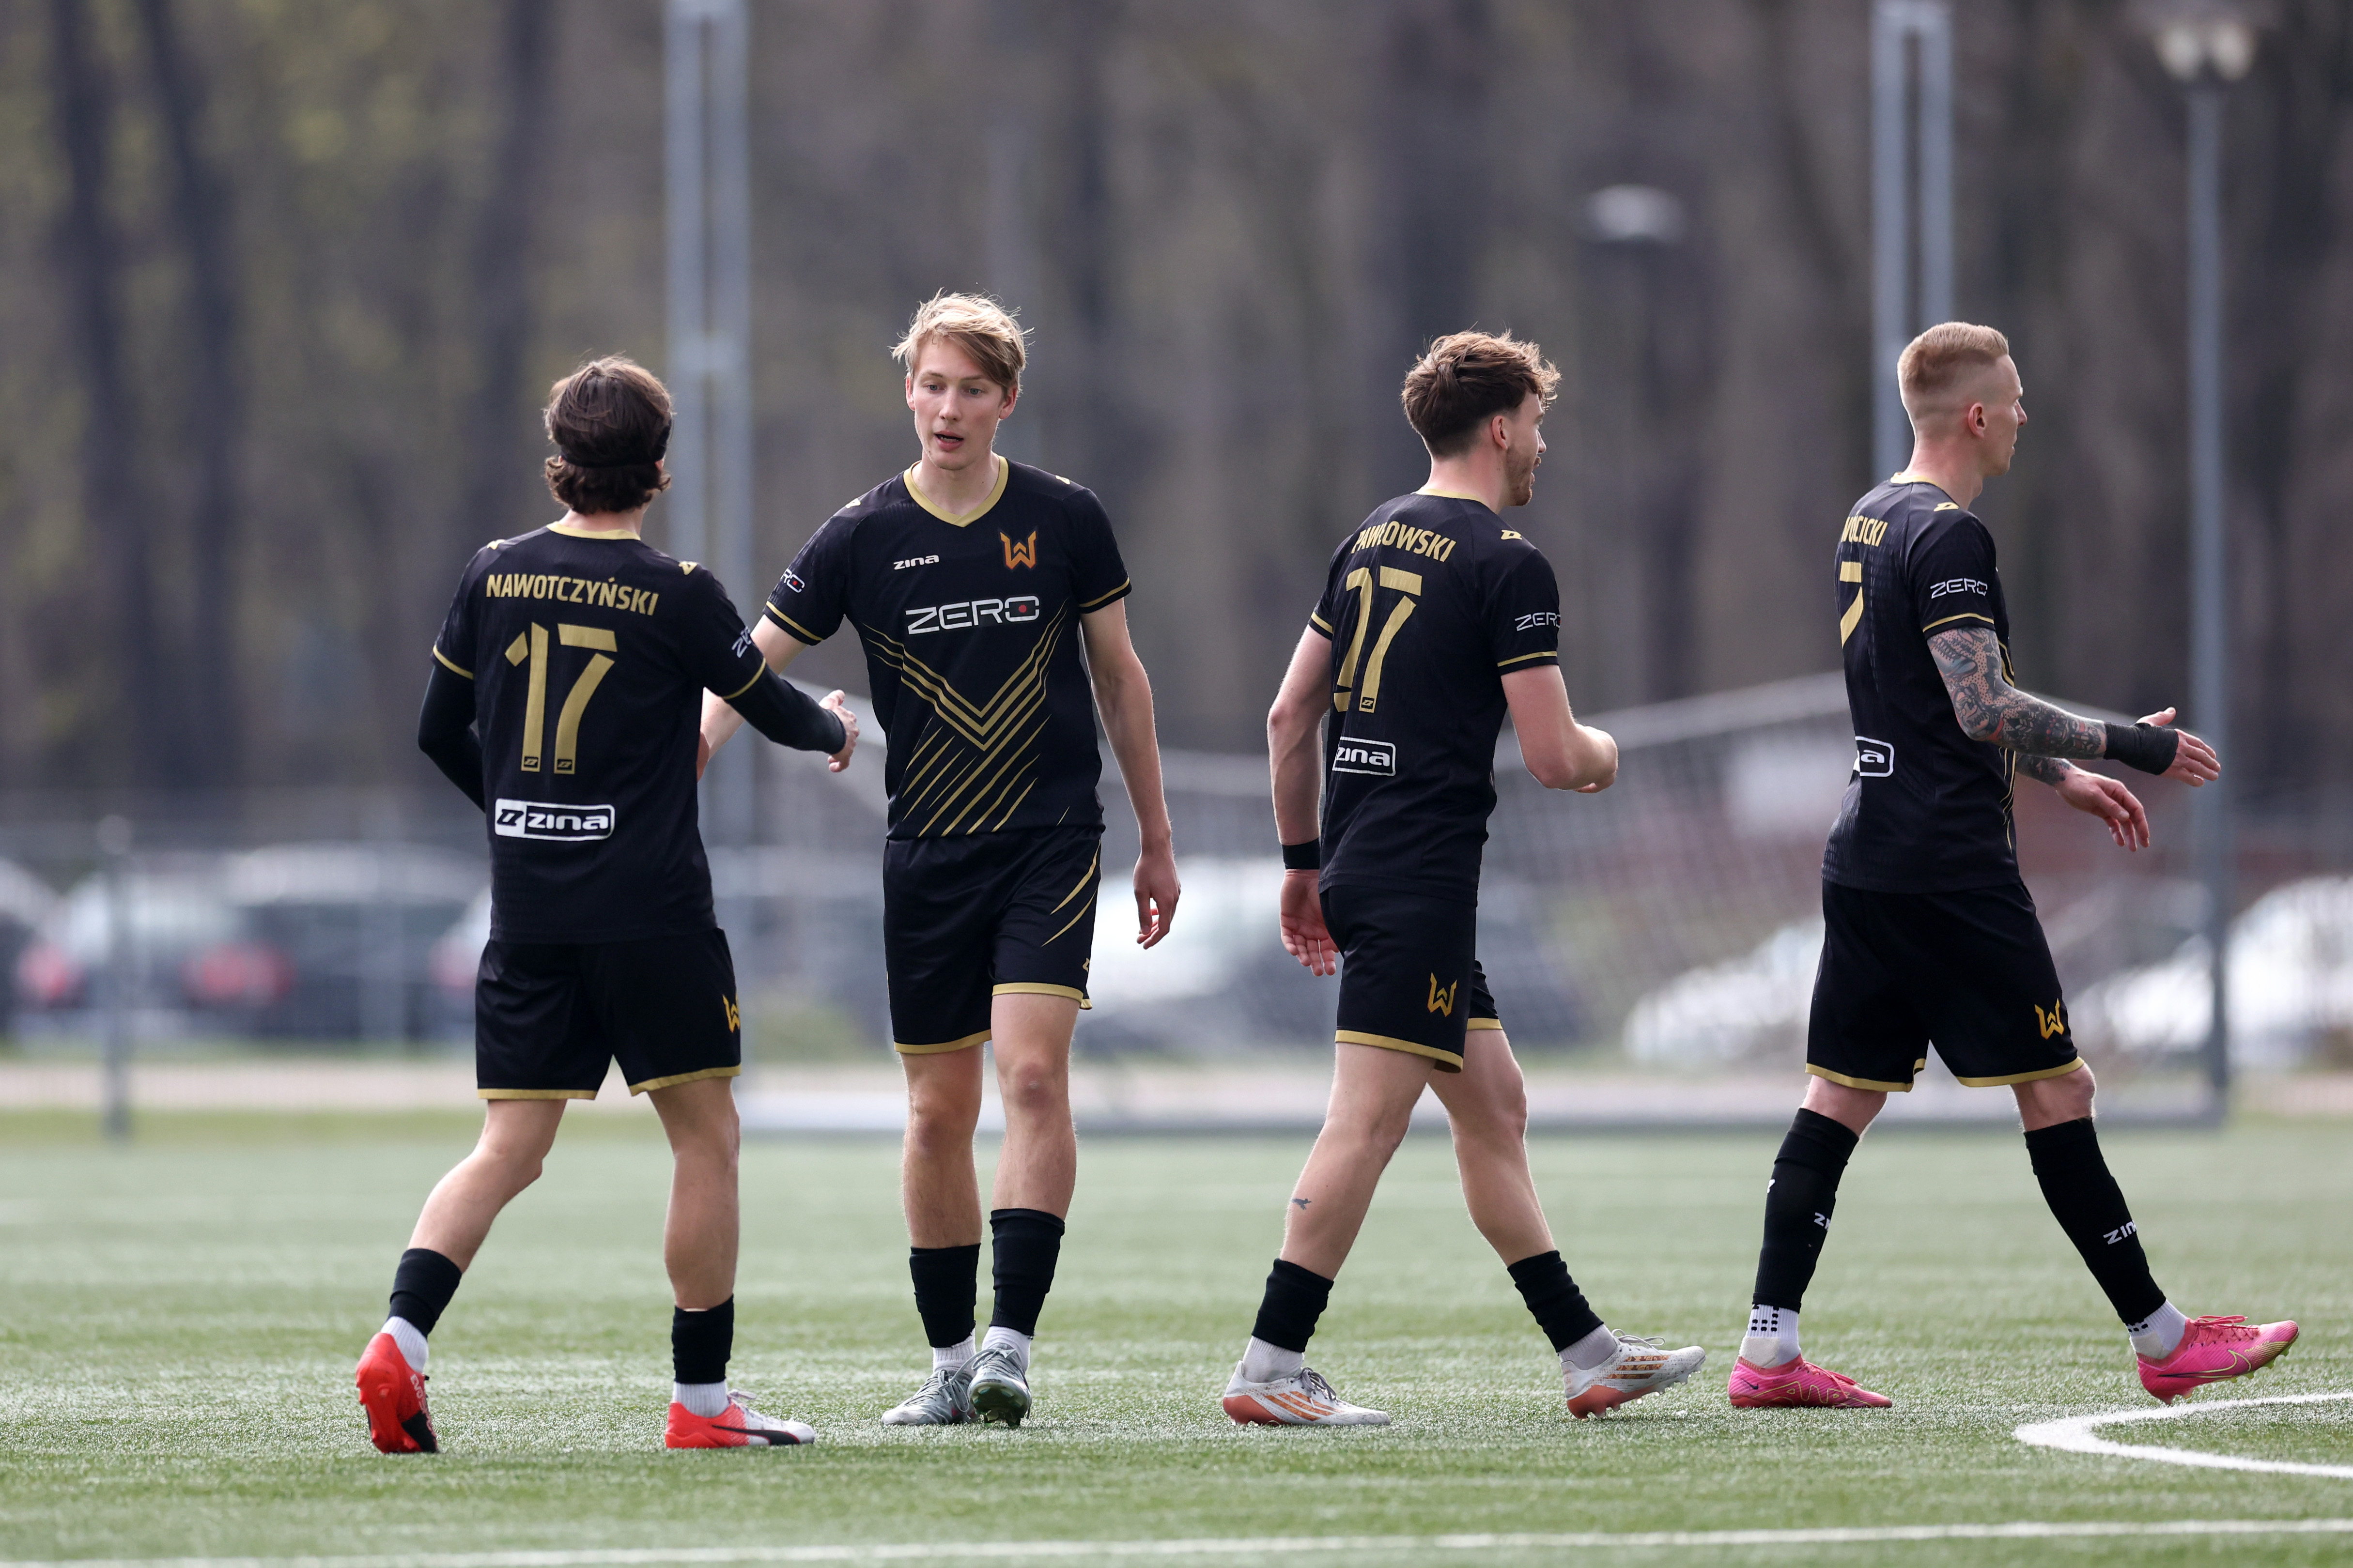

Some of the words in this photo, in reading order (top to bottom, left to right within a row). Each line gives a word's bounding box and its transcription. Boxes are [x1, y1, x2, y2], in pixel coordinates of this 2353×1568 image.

[894, 554, 939, 569] zina
[486, 573, 659, 616] NAWOTCZYŃSKI
[780, 568, 805, 593] RO
[1930, 578, 1988, 599] ZERO
[905, 596, 1039, 635] ZERO
[731, 626, 751, 658] ZE
[505, 622, 618, 775] 17
[527, 812, 609, 831] zina
